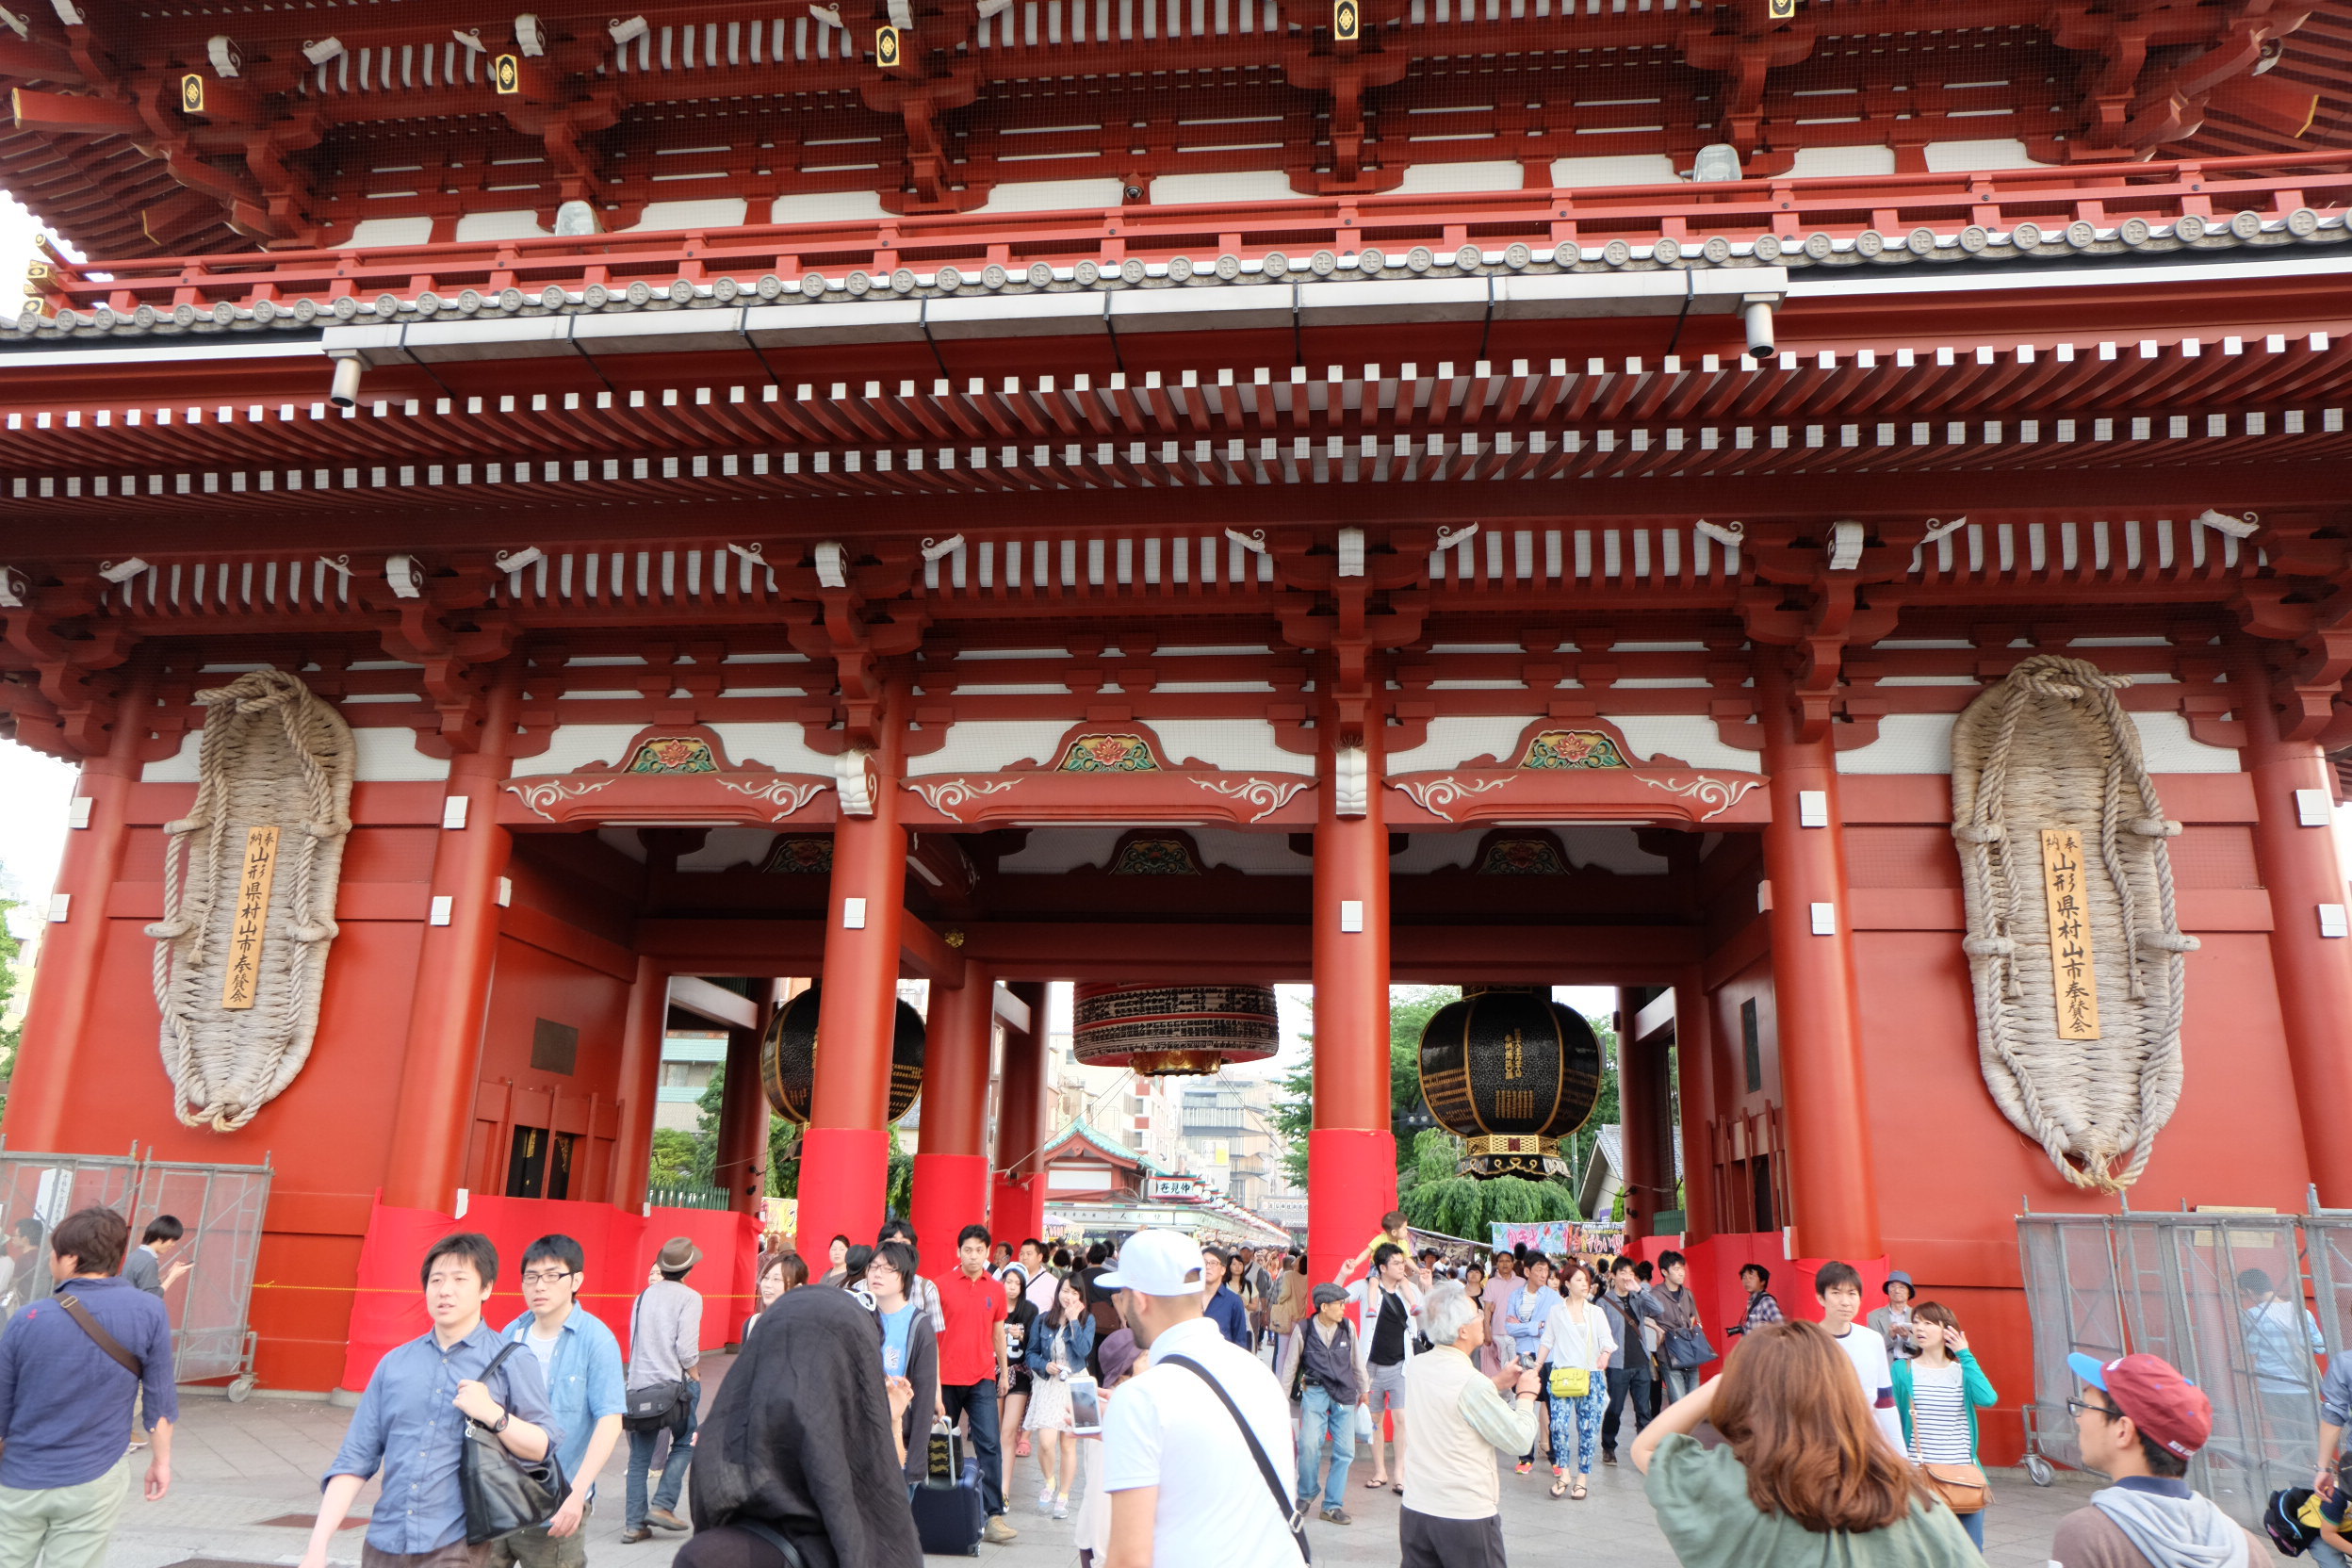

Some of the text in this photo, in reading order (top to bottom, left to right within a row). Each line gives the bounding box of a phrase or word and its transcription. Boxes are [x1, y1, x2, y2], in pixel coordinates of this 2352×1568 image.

[250, 831, 274, 847] 奉納
[2045, 836, 2078, 852] 奉納
[229, 846, 270, 1003] 山形県村山市奉賛会
[2052, 852, 2093, 1034] 山形県村山市奉賛会
